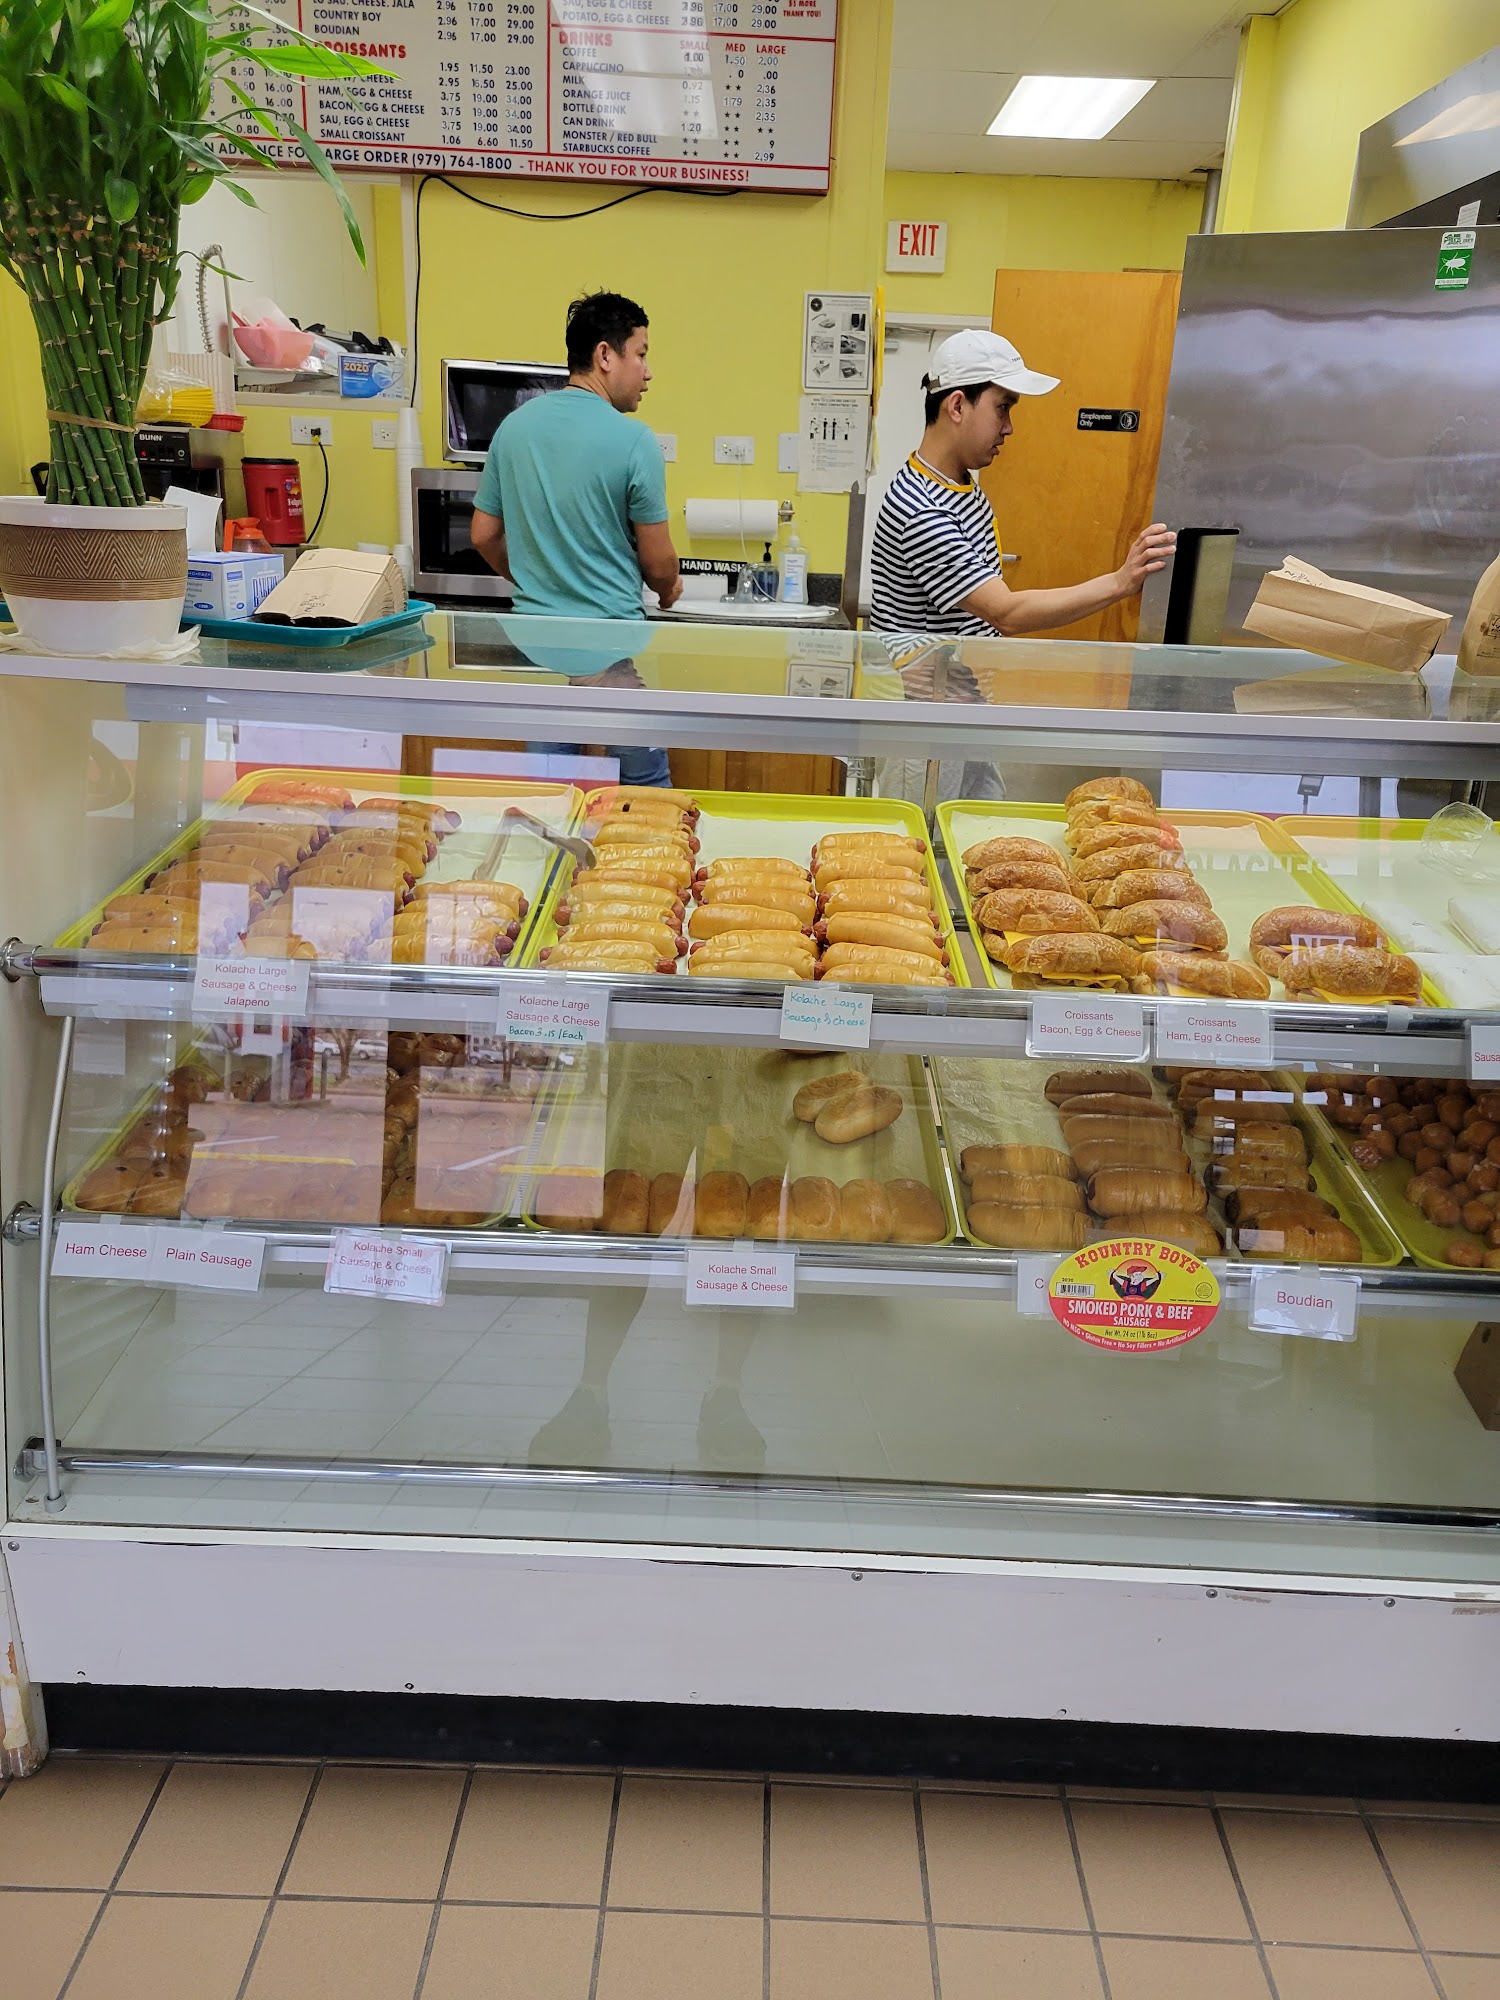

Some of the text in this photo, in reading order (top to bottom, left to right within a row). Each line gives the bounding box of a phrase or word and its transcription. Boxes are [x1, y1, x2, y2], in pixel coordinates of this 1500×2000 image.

[507, 4, 535, 15] 29.00
[313, 9, 534, 30] COUNTRY BOY 2.96 17.00 29.00
[604, 13, 624, 23] EGG
[635, 14, 671, 25] CHEESE
[314, 24, 535, 45] BOUDIAN 2.96 17.00 29.00
[559, 31, 787, 54] DRINKS SMALL MED LARGE
[562, 47, 779, 66] COFFEE 1.50 2.00
[440, 62, 530, 76] 1.95 11.50 23.00
[562, 61, 624, 73] CAPPUCCINO
[438, 77, 533, 91] 2.95 25.00
[562, 75, 585, 85] MILK
[318, 86, 532, 105] HAM, & CHEESE 3.75 19.00 34.00
[562, 89, 631, 101] ORANGE JUICE
[319, 100, 532, 120] BACON, & CHEESE 3.75 19.00 34.00
[562, 103, 627, 114] BOTTLE DRINK
[320, 114, 341, 126] SAU,
[344, 116, 364, 126] EGG
[376, 118, 410, 128] CHEESE
[442, 121, 461, 131] 3.75
[473, 122, 498, 132] 19.00
[562, 116, 615, 128] CAN DRINK
[320, 129, 533, 149] SMALL CROISSANT 1.06 6.60 11.50
[562, 130, 607, 141] MONSTER
[617, 132, 634, 142] RED
[636, 134, 658, 144] BULL
[562, 143, 651, 156] STARBUCKS COFFEE
[364, 150, 749, 182] ORDER (979) 764-1800 THANK YOU FOR YOUR BUSINESS!
[899, 224, 940, 256] EXIT
[1079, 419, 1094, 427] Only
[1080, 412, 1112, 420] Employees
[681, 559, 712, 571] HAND
[215, 963, 287, 977] Kolache Large
[201, 978, 297, 992] Sausage & Cheese
[224, 996, 270, 1008] Jalapeno
[519, 995, 590, 1011] Kolache Large
[834, 997, 864, 1016] Large
[506, 1010, 600, 1027] Sausage & Cheese
[1064, 1010, 1114, 1021] Croissants
[1187, 1017, 1237, 1028] Croissants
[509, 1025, 535, 1036] Bacon
[1040, 1024, 1141, 1037] Bacon, Egg & Cheese
[1166, 1031, 1261, 1044] Ham, Egg & Cheese
[65, 1242, 148, 1258] Ham Cheese
[353, 1241, 423, 1258] Kolache Small
[165, 1247, 253, 1270] Plain Sausage
[1074, 1241, 1201, 1275] KOUNTRY BOYS
[339, 1256, 432, 1275] Sausage & Cheese
[708, 1264, 777, 1276] Kolache Small
[361, 1274, 406, 1289] Jalapeno
[696, 1279, 788, 1292] Sausage & Cheese
[1276, 1290, 1333, 1309] Boudian
[1067, 1299, 1194, 1320] SMOKED PORK & BEEF
[1113, 1316, 1150, 1328] SAUSAGE
[1104, 1329, 1113, 1337] Net
[1085, 1332, 1101, 1343] Gluten
[1101, 1337, 1112, 1346] Free
[1136, 1341, 1152, 1349] Fillers
[1165, 1332, 1187, 1345] Artificial
